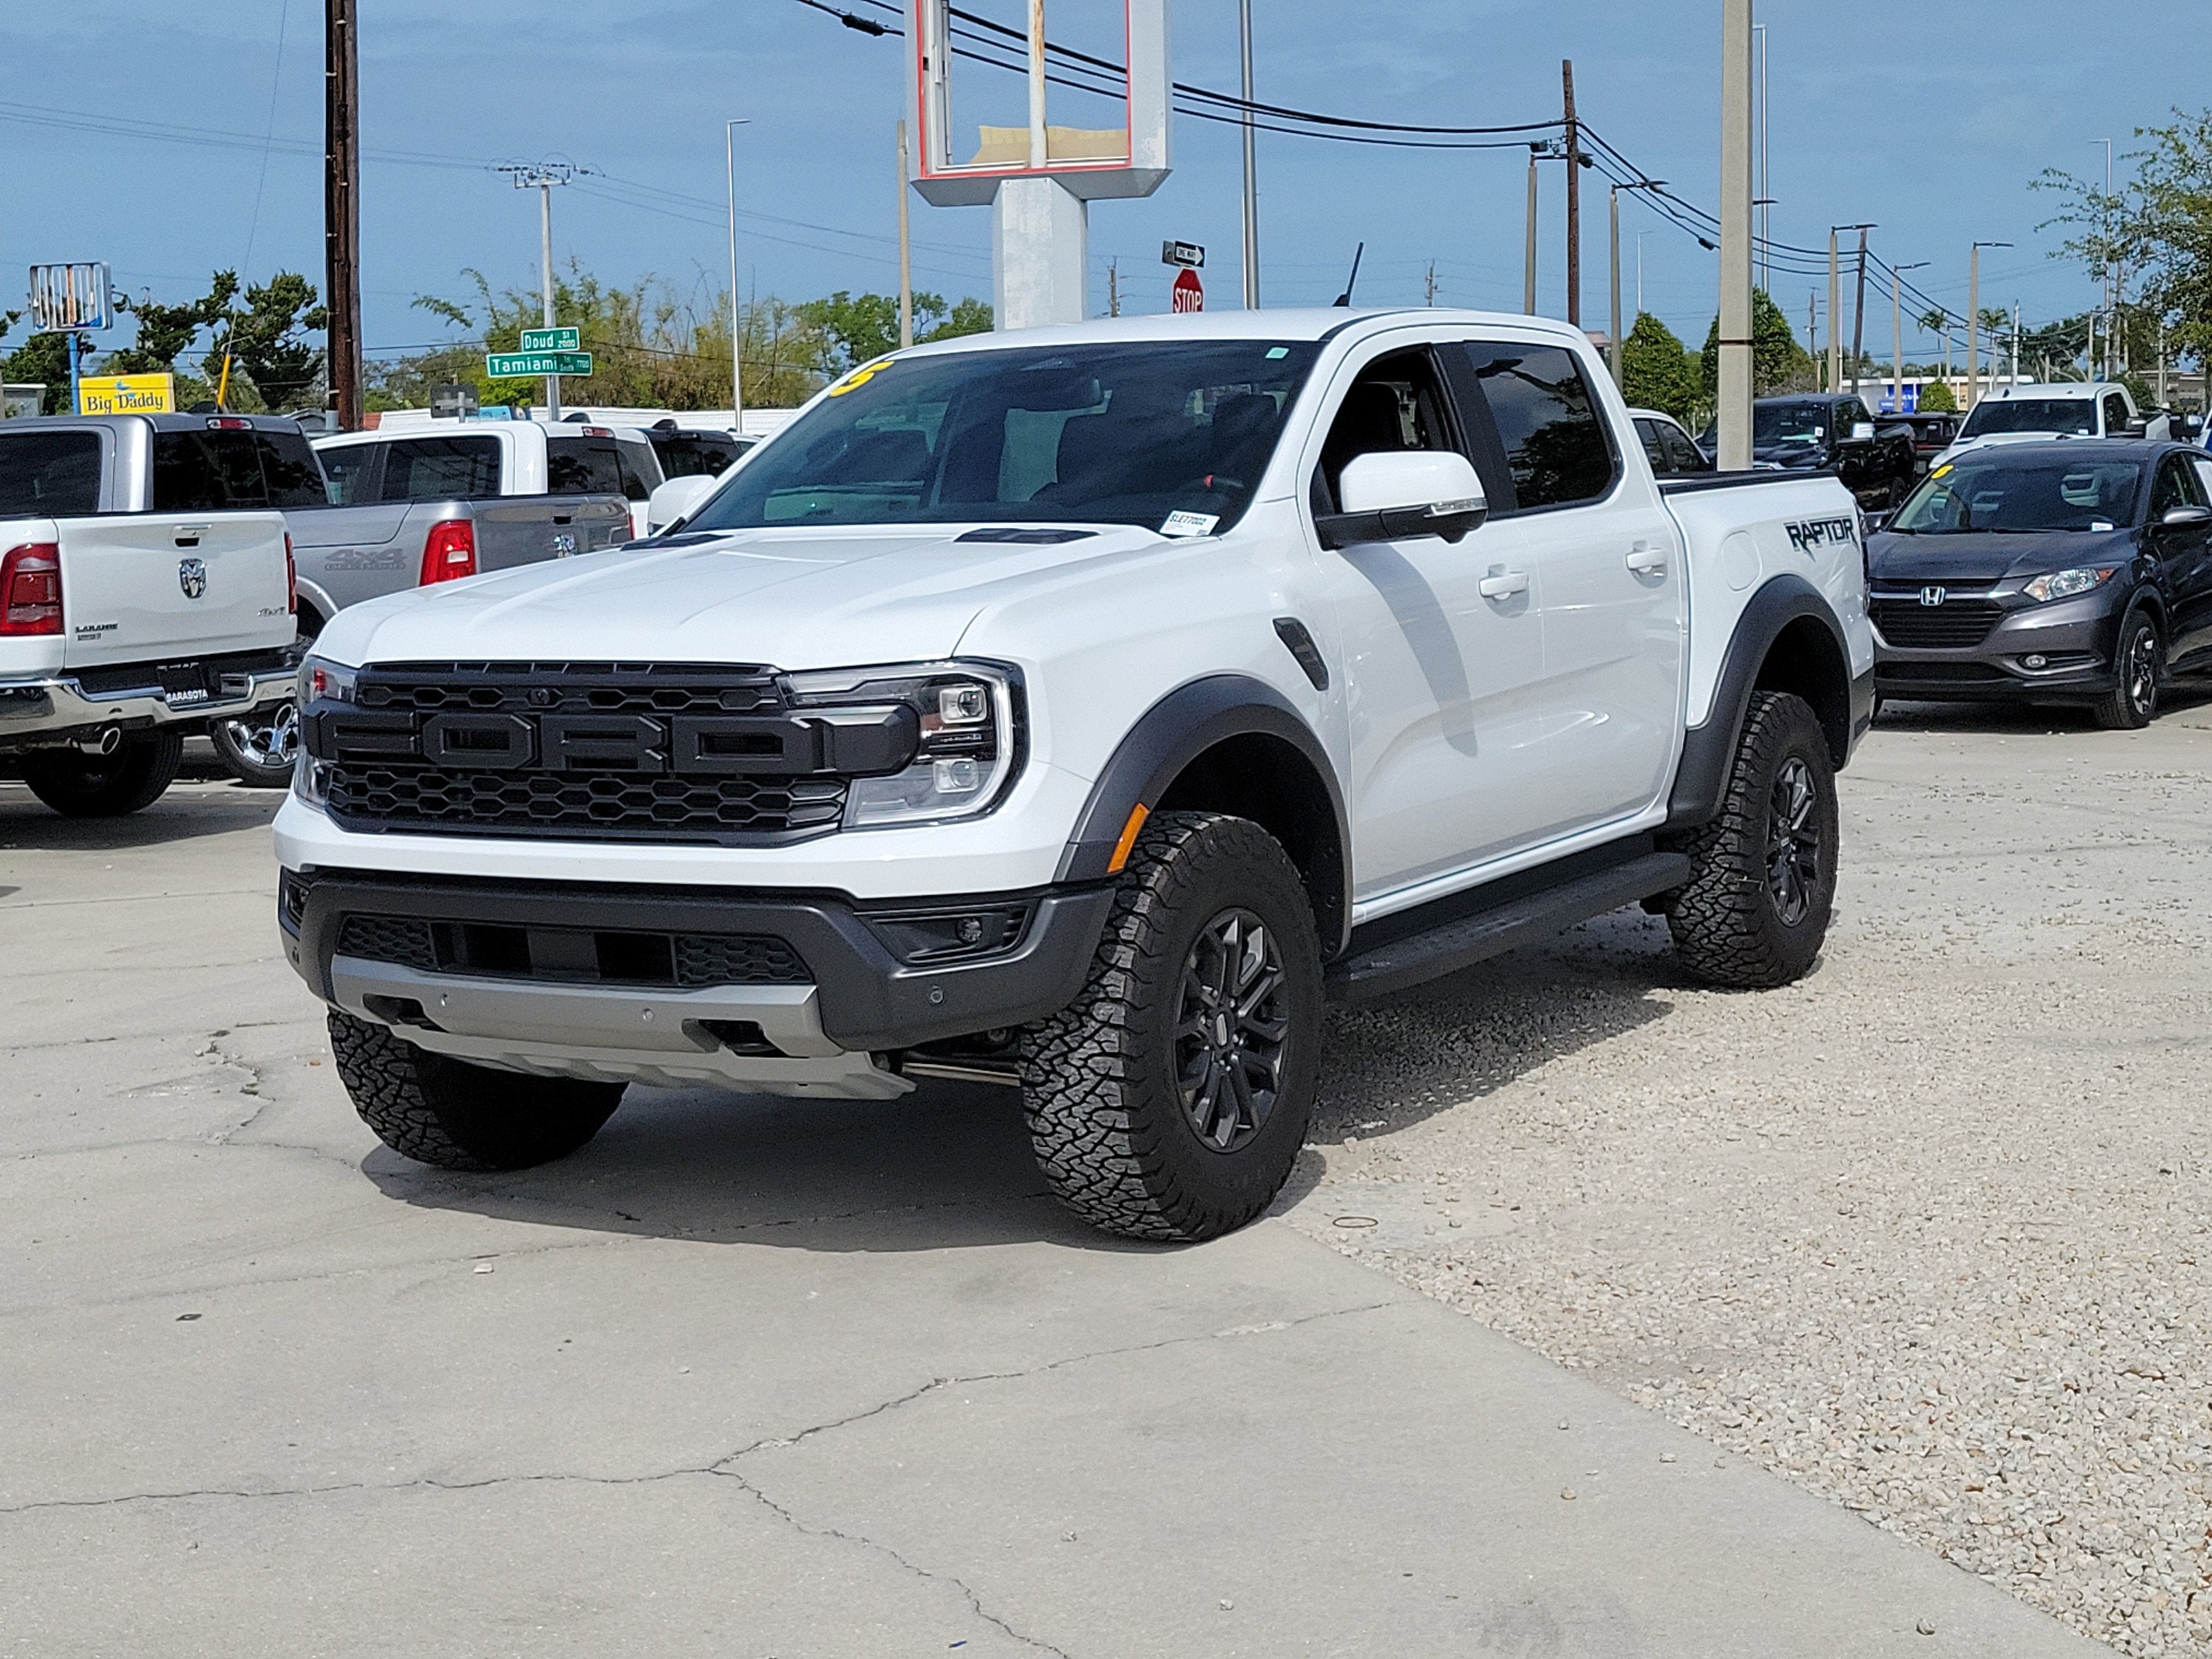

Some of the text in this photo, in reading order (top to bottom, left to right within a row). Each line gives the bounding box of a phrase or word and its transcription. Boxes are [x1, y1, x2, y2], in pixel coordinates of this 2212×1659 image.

[1174, 287, 1202, 313] STOP
[524, 334, 554, 349] Doud
[492, 357, 557, 373] Tamiami
[87, 392, 163, 414] Big Daddy
[1783, 516, 1861, 563] RAPTOR
[166, 689, 208, 703] SARASOTA
[317, 710, 815, 774] FORD
